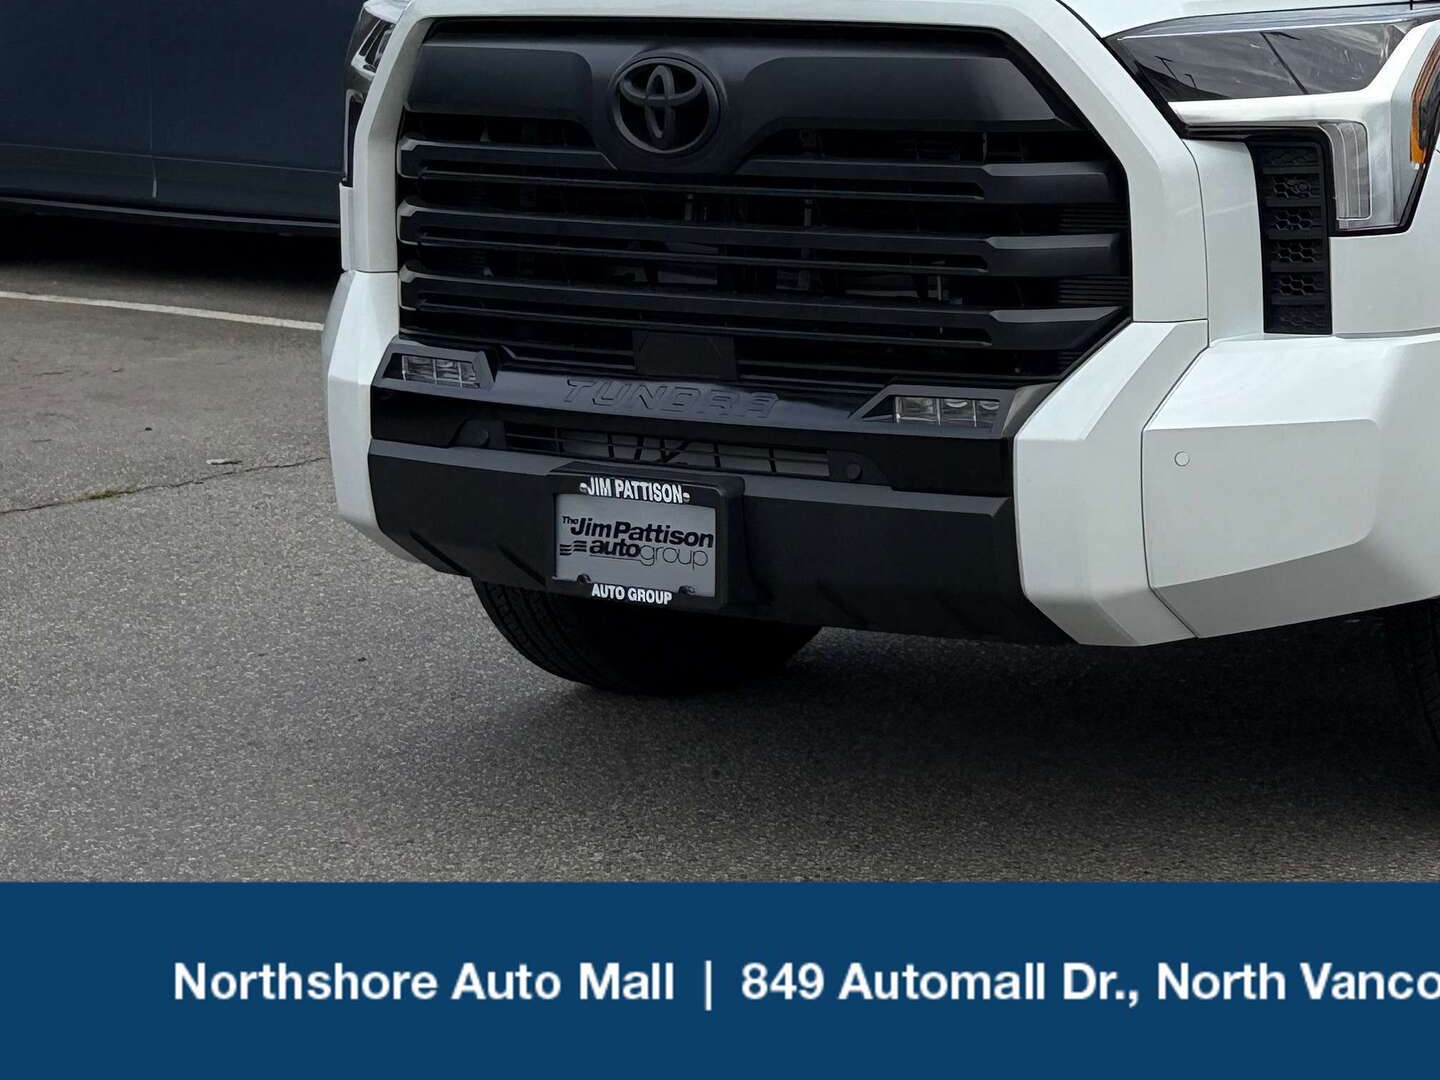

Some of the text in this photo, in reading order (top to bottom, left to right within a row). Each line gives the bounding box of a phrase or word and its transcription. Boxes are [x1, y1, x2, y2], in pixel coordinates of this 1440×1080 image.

[588, 476, 683, 504] JIM PATTISON
[591, 583, 673, 605] AUTO GROUP
